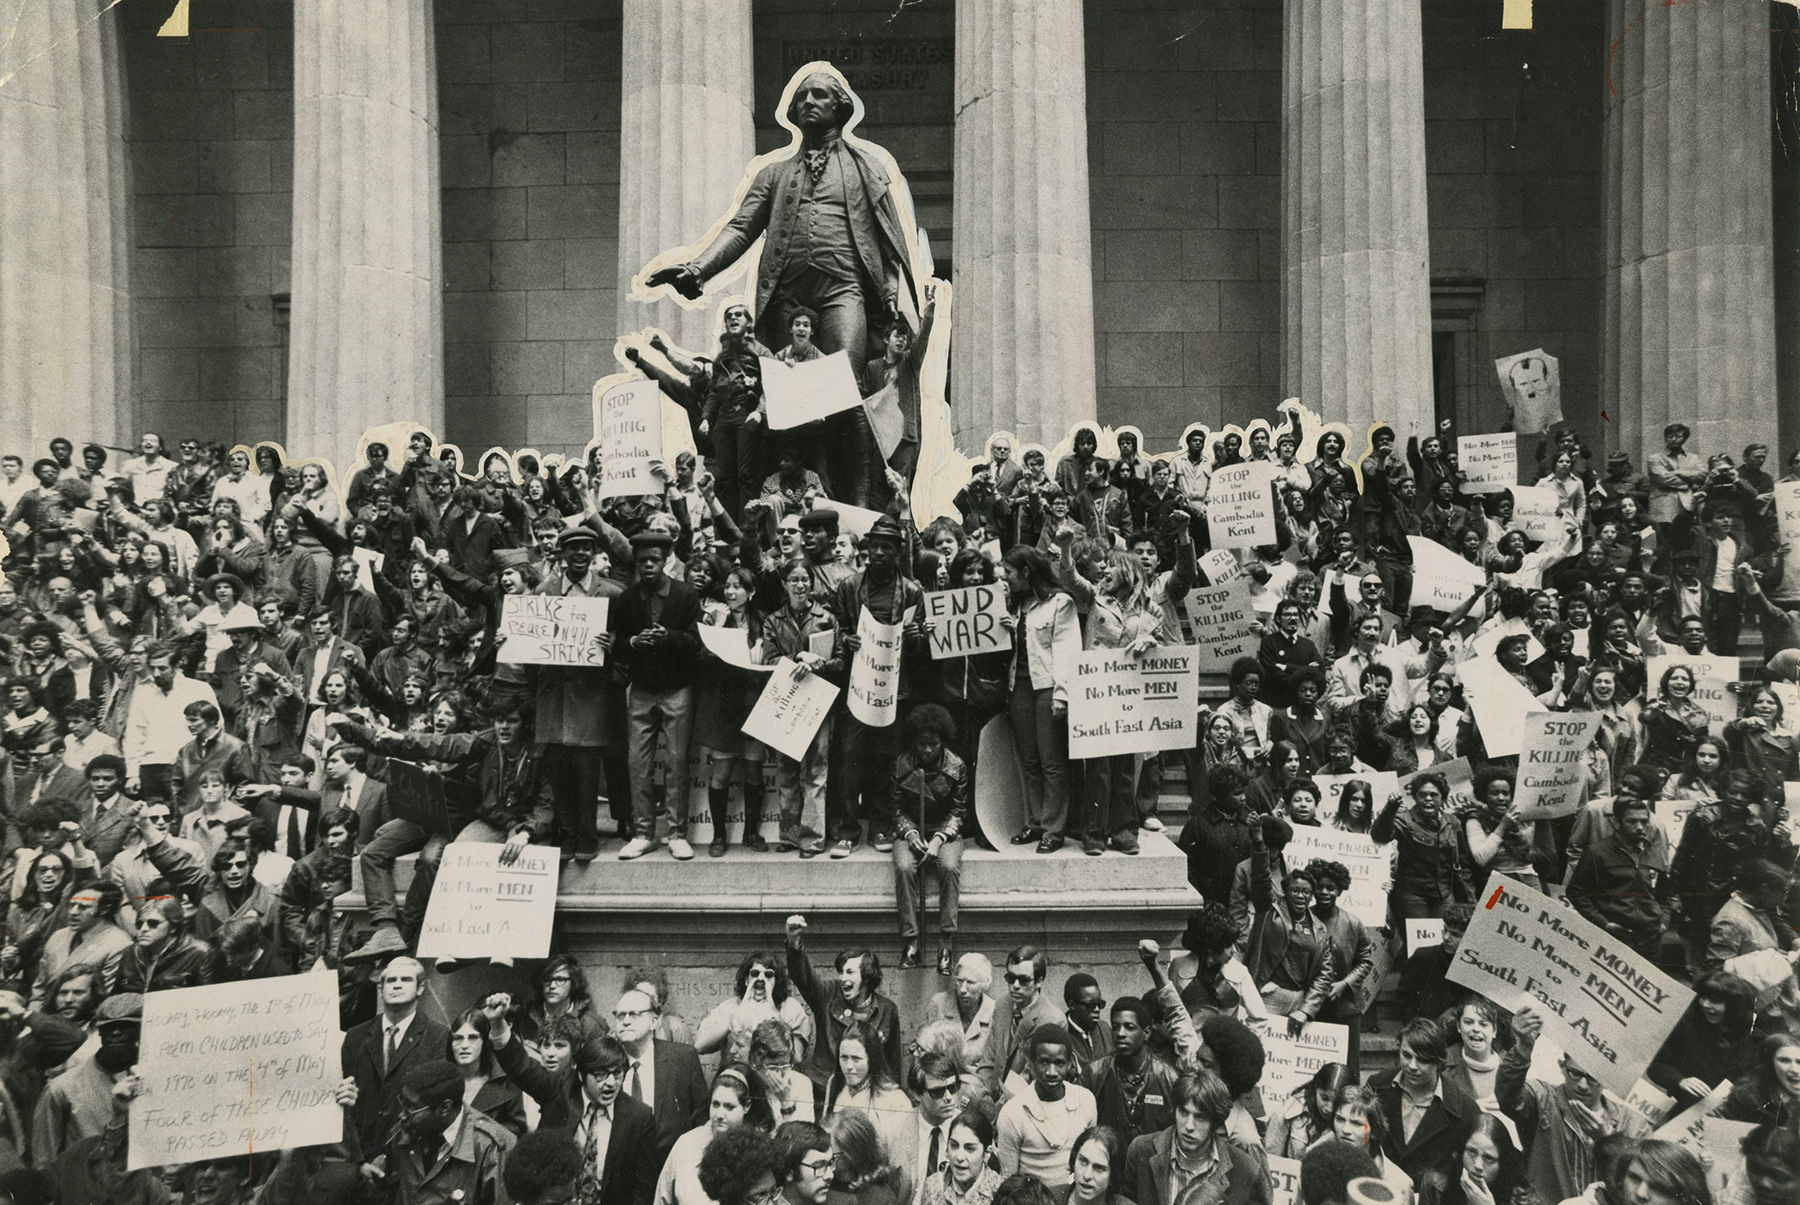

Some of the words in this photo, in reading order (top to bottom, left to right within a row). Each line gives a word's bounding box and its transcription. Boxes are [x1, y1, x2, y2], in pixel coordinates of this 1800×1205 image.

[788, 45, 862, 65] UNITED
[873, 44, 955, 65] STATES
[607, 392, 635, 412] STOP
[606, 467, 638, 482] Kent
[1218, 469, 1250, 484] STOP
[1230, 482, 1242, 490] the
[1212, 490, 1261, 506] KILLING
[1213, 510, 1265, 524] Cambodia
[1227, 525, 1256, 538] Kent
[1525, 520, 1546, 530] Kent
[1196, 590, 1230, 606] STOP
[1433, 586, 1463, 601] Kent
[929, 587, 994, 616] END
[1210, 603, 1224, 612] the
[507, 596, 566, 623] STRIKE
[1194, 610, 1244, 627] KILLING
[562, 625, 589, 646] NYU
[932, 612, 998, 654] WAR
[1217, 625, 1226, 633] in
[1198, 630, 1250, 645] Cambodia
[532, 643, 601, 666] STRIKE
[1213, 644, 1243, 659] Kent
[866, 654, 895, 673] More
[1078, 664, 1098, 676] No
[1104, 660, 1138, 673] More
[1141, 657, 1190, 672] MONEY
[874, 678, 887, 687] to
[1085, 687, 1105, 700] No
[1108, 685, 1141, 698] More
[1144, 681, 1178, 696] MEN
[867, 690, 894, 708] East
[1122, 703, 1134, 712] to
[1072, 722, 1111, 740] South
[1115, 720, 1143, 734] East
[1148, 717, 1183, 732] Asia
[1544, 721, 1588, 736] STOP
[1558, 738, 1575, 747] the
[1528, 750, 1584, 764] KILLIN
[1555, 766, 1564, 774] in
[690, 776, 706, 788] No
[1537, 793, 1567, 807] Kent
[1306, 836, 1335, 850] More
[1338, 842, 1382, 855] MONEY
[457, 856, 492, 868] More
[1287, 854, 1304, 867] No
[457, 881, 493, 893] More
[498, 882, 534, 896] MEN
[468, 903, 483, 911] to
[1343, 895, 1373, 908] Asia
[457, 919, 491, 935] East
[1416, 930, 1436, 940] No
[1498, 890, 1530, 914] No
[1536, 910, 1590, 950] More
[1593, 945, 1670, 1006] MONEY
[1496, 921, 1527, 944] No
[1530, 936, 1581, 979] More
[1585, 972, 1637, 1019] MEN
[1546, 968, 1563, 985] to
[668, 982, 702, 997] THIS
[709, 982, 735, 997] SIT
[284, 995, 299, 1015] of
[1459, 949, 1519, 987] South
[1522, 976, 1568, 1018] East
[1569, 1016, 1618, 1065] Asia
[199, 1033, 261, 1055] CHILDREN
[1295, 1032, 1339, 1048] MONEY
[1296, 1056, 1327, 1070] MEN
[164, 1074, 195, 1093] 1970
[224, 1067, 249, 1083] THE
[275, 1058, 291, 1081] of
[1271, 1071, 1283, 1080] to
[1261, 1085, 1290, 1103] East
[200, 1103, 222, 1127] of
[166, 1131, 228, 1153] PASSED
[238, 1126, 289, 1149] AWAY
